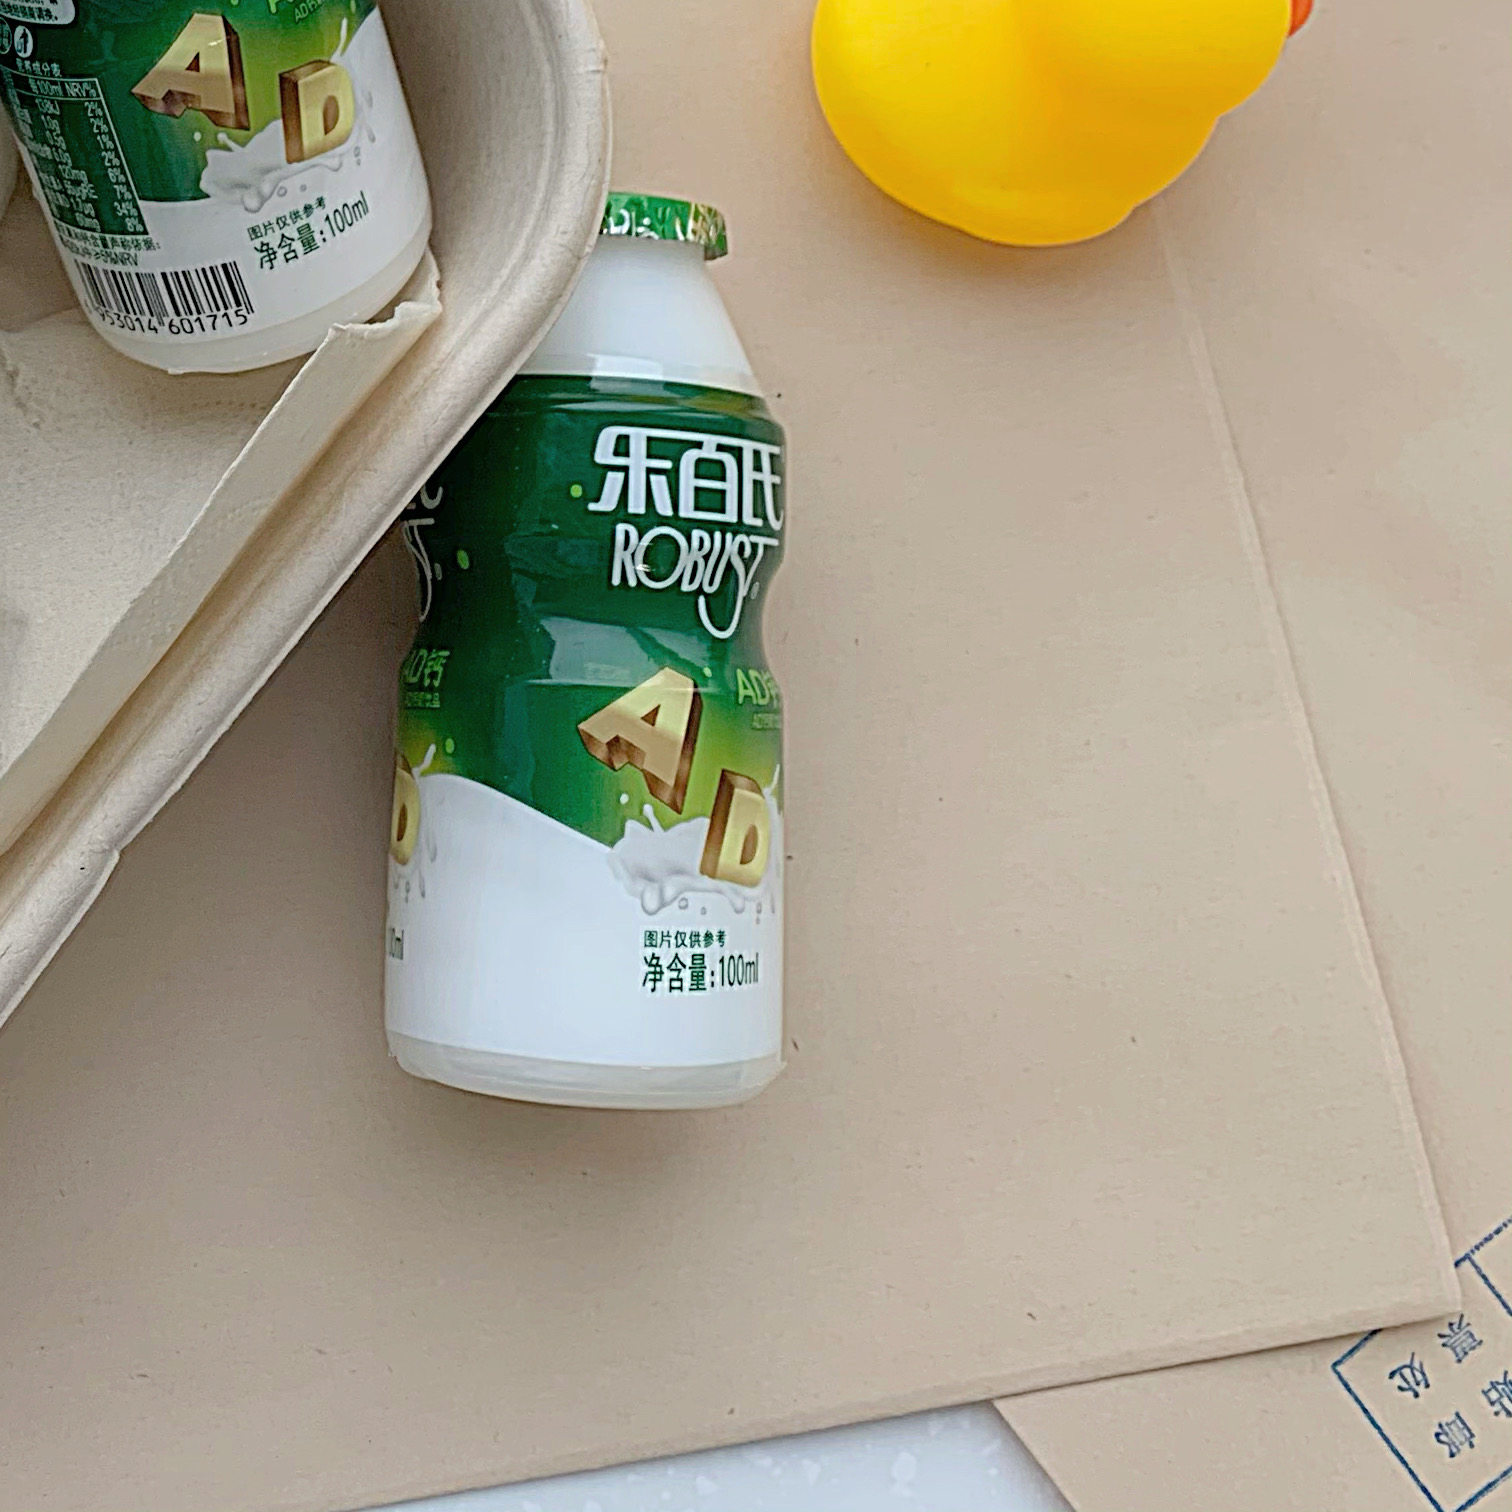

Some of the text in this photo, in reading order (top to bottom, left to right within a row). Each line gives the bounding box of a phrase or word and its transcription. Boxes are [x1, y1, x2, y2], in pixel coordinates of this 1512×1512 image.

[247, 195, 327, 241] 图片仅供参考
[254, 190, 370, 271] 净含量：100ml
[168, 308, 248, 335] 601715
[588, 424, 784, 531] 乐百氏
[611, 522, 780, 640] ROBUST
[643, 929, 728, 949] 图片仅供参考
[641, 951, 760, 995] 净含量：100ml
